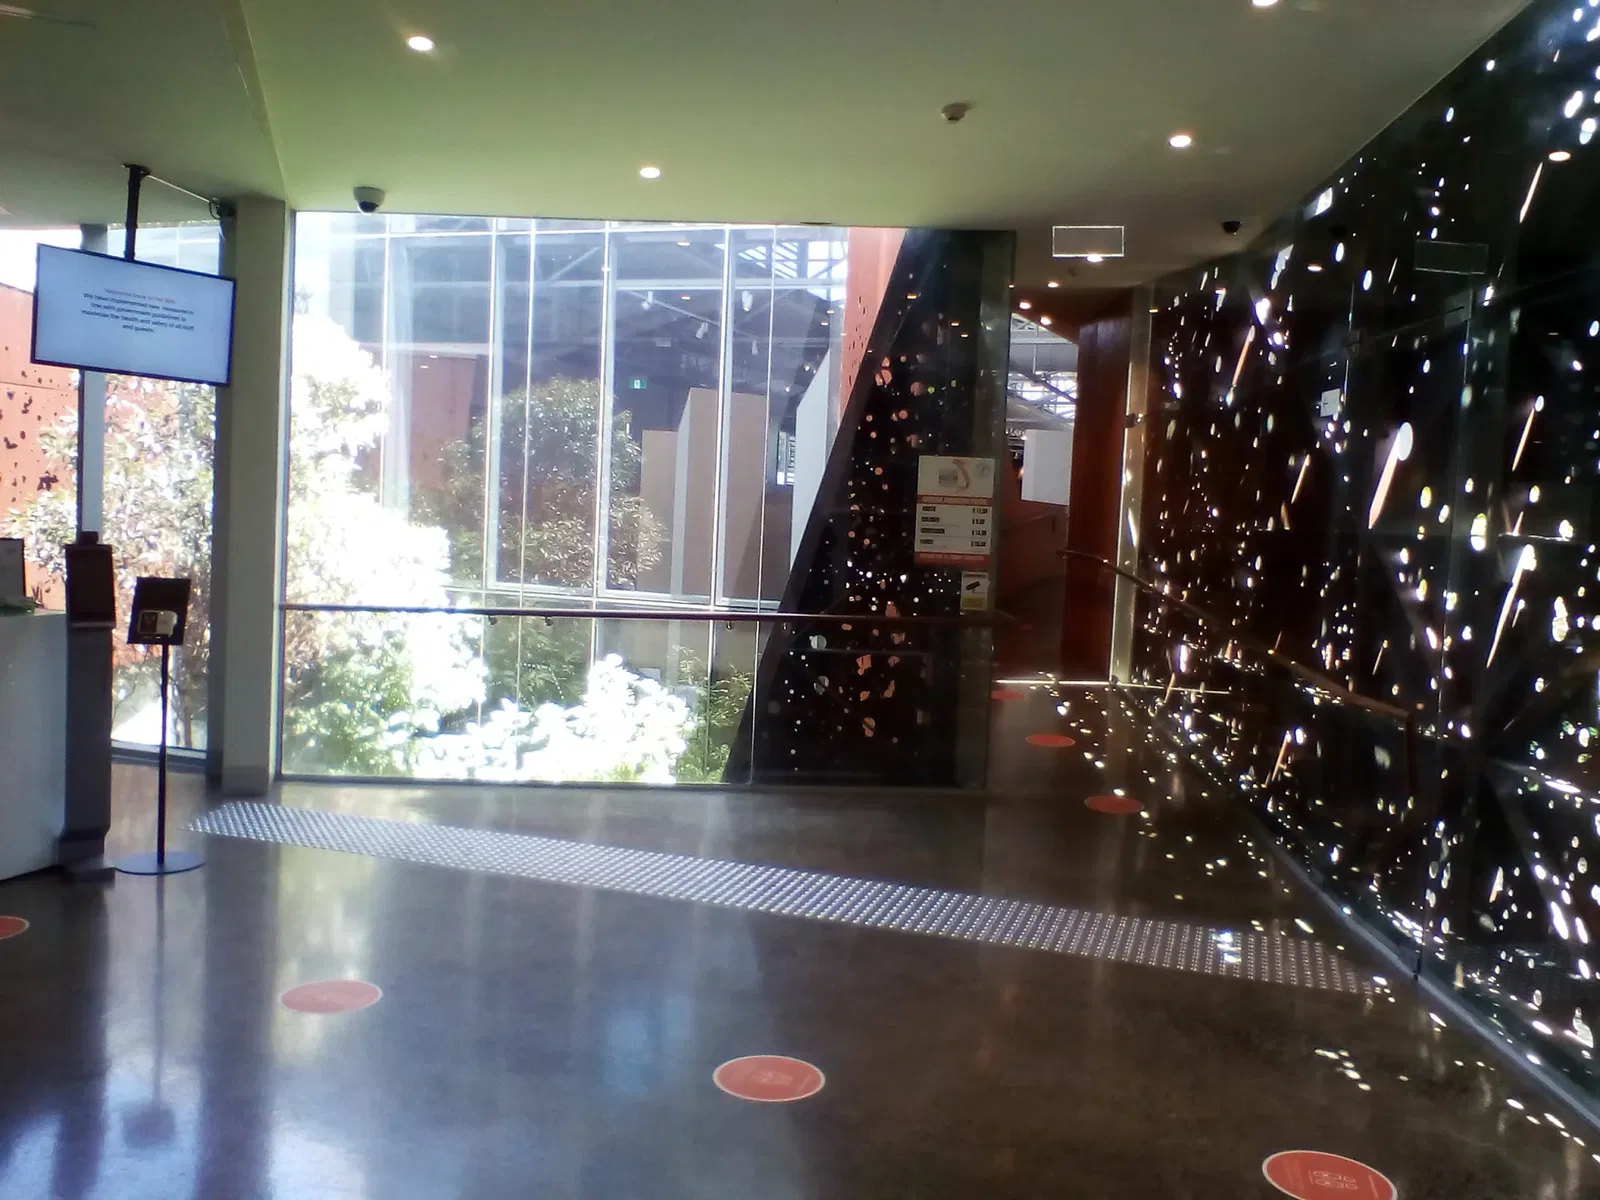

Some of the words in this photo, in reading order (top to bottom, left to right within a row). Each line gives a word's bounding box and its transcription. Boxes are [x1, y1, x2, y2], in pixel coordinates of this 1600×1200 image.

[109, 297, 148, 308] implemented
[116, 307, 151, 316] government
[152, 312, 180, 321] guidelines
[151, 320, 168, 328] safety
